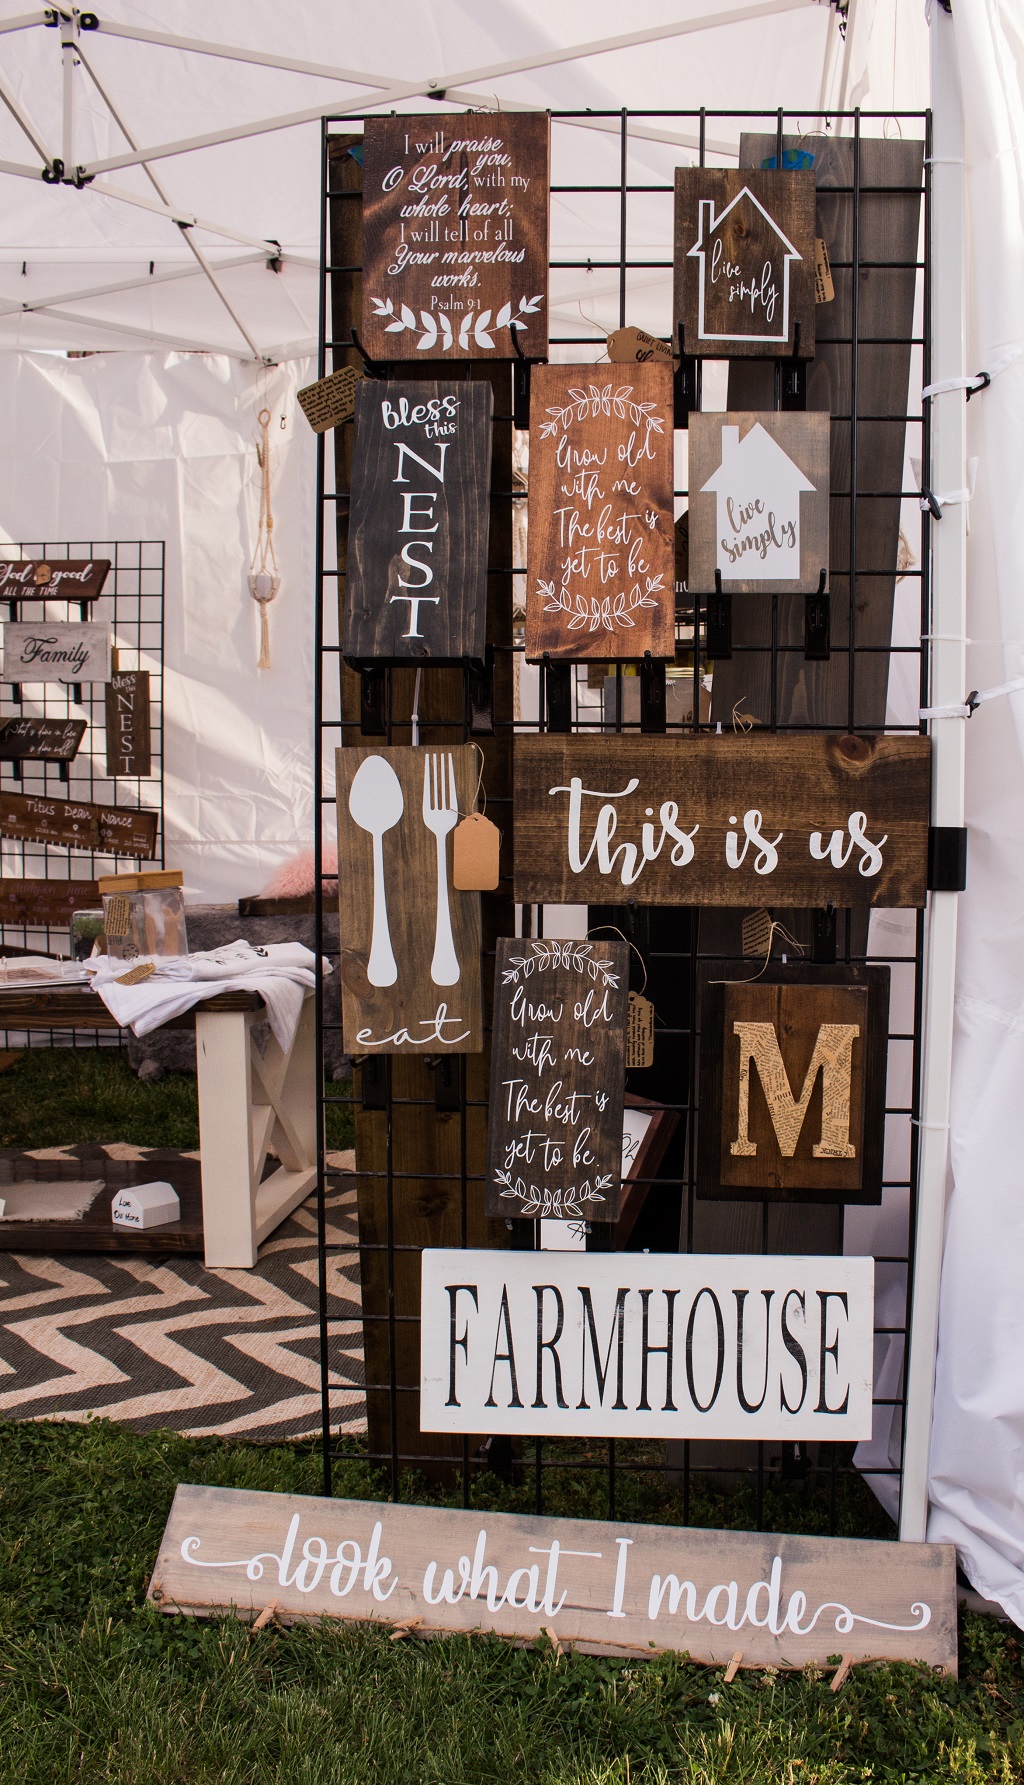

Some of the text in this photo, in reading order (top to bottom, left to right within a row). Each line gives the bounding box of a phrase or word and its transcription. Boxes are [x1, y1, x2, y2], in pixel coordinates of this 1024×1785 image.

[404, 132, 503, 161] I will praise
[470, 150, 512, 176] you,
[382, 164, 530, 193] O Lord, with my
[400, 195, 451, 217] whole
[400, 219, 513, 242] I will tell of all
[388, 242, 526, 275] Your marvelous
[431, 266, 482, 287] works.
[431, 295, 464, 310] Psalm
[728, 261, 779, 322] simply
[424, 422, 458, 439] this
[556, 431, 656, 473] Grow old
[561, 469, 642, 510] with me
[553, 507, 594, 547] The
[596, 504, 642, 545] best
[645, 510, 658, 530] is
[726, 496, 765, 534] live
[390, 442, 450, 638] NEST
[720, 512, 796, 563] simply
[49, 564, 93, 586] good
[561, 546, 601, 586] yet
[594, 552, 620, 584] to
[628, 538, 650, 578] be
[3, 586, 59, 596] ALL THE TIME
[20, 637, 90, 674] Family
[117, 694, 135, 774] NEST
[26, 798, 133, 828] Titus Dean Nance
[726, 809, 783, 875] is
[809, 811, 888, 877] us
[356, 1002, 470, 1046] eat
[510, 986, 613, 1028] Grow old
[512, 1032, 594, 1077] with me
[502, 1079, 610, 1125] The best is
[730, 1021, 860, 1158] M
[504, 1130, 547, 1170] yet
[539, 1138, 566, 1172] to
[444, 1283, 851, 1415] FARMHOUSE
[423, 1529, 602, 1618] what
[606, 1538, 634, 1618] I
[648, 1556, 854, 1635] made
